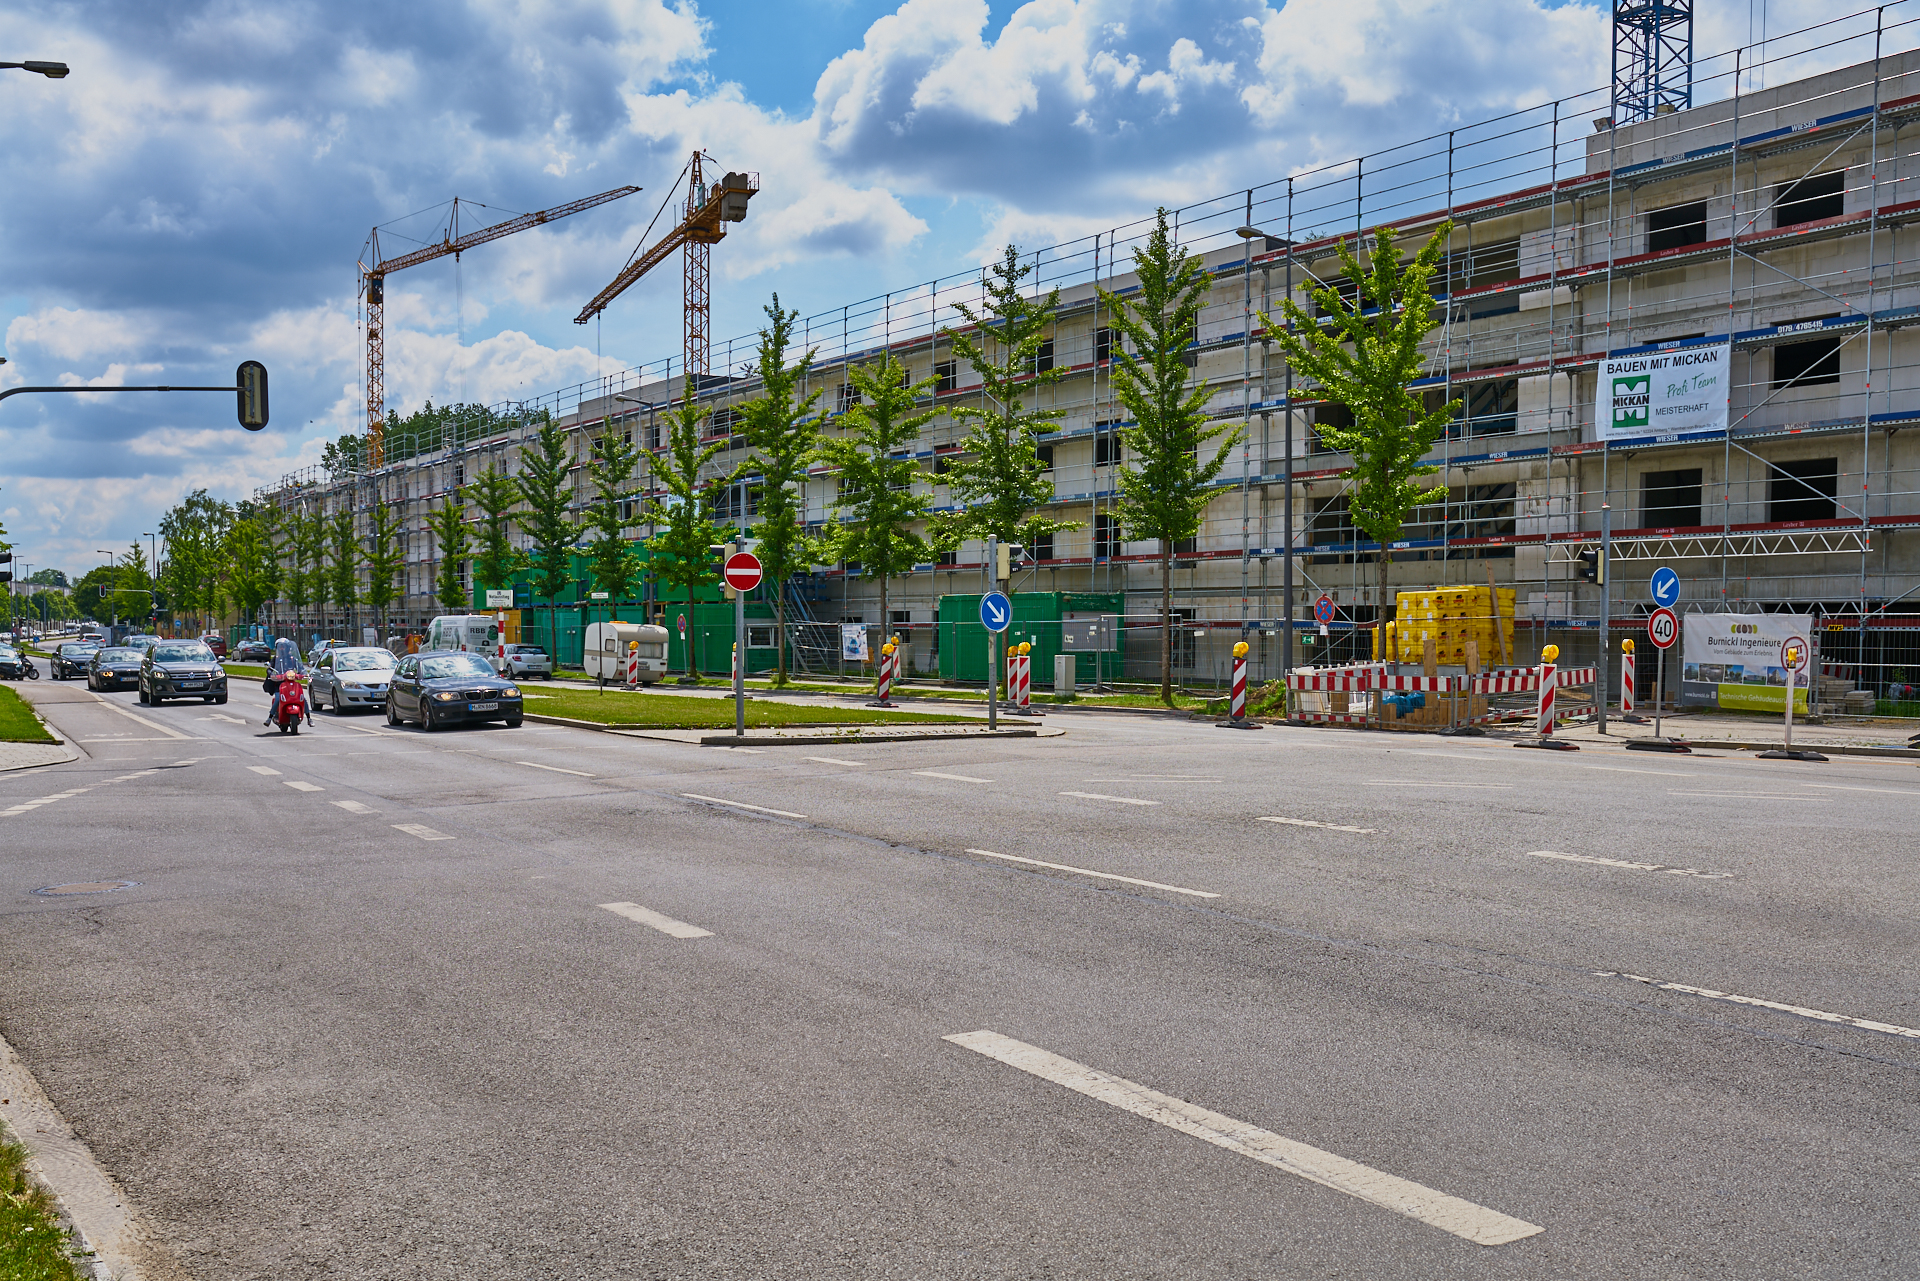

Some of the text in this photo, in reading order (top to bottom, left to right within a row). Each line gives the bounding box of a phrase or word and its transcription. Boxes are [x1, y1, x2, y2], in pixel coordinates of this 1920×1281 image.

[1791, 120, 1817, 132] WIESER
[1662, 153, 1685, 164] WIESER
[1658, 341, 1680, 350] WIESER
[1607, 351, 1718, 374] BAUEN MIT MICKAN
[1667, 373, 1716, 398] Profi Team
[1612, 395, 1650, 407] MICKAN
[1656, 403, 1709, 416] MEISTERHAFT
[1656, 435, 1678, 443] WIESER
[1655, 620, 1672, 638] 40
[1708, 636, 1782, 649] Burnickl Ingenieure
[1720, 692, 1748, 701] Technische
